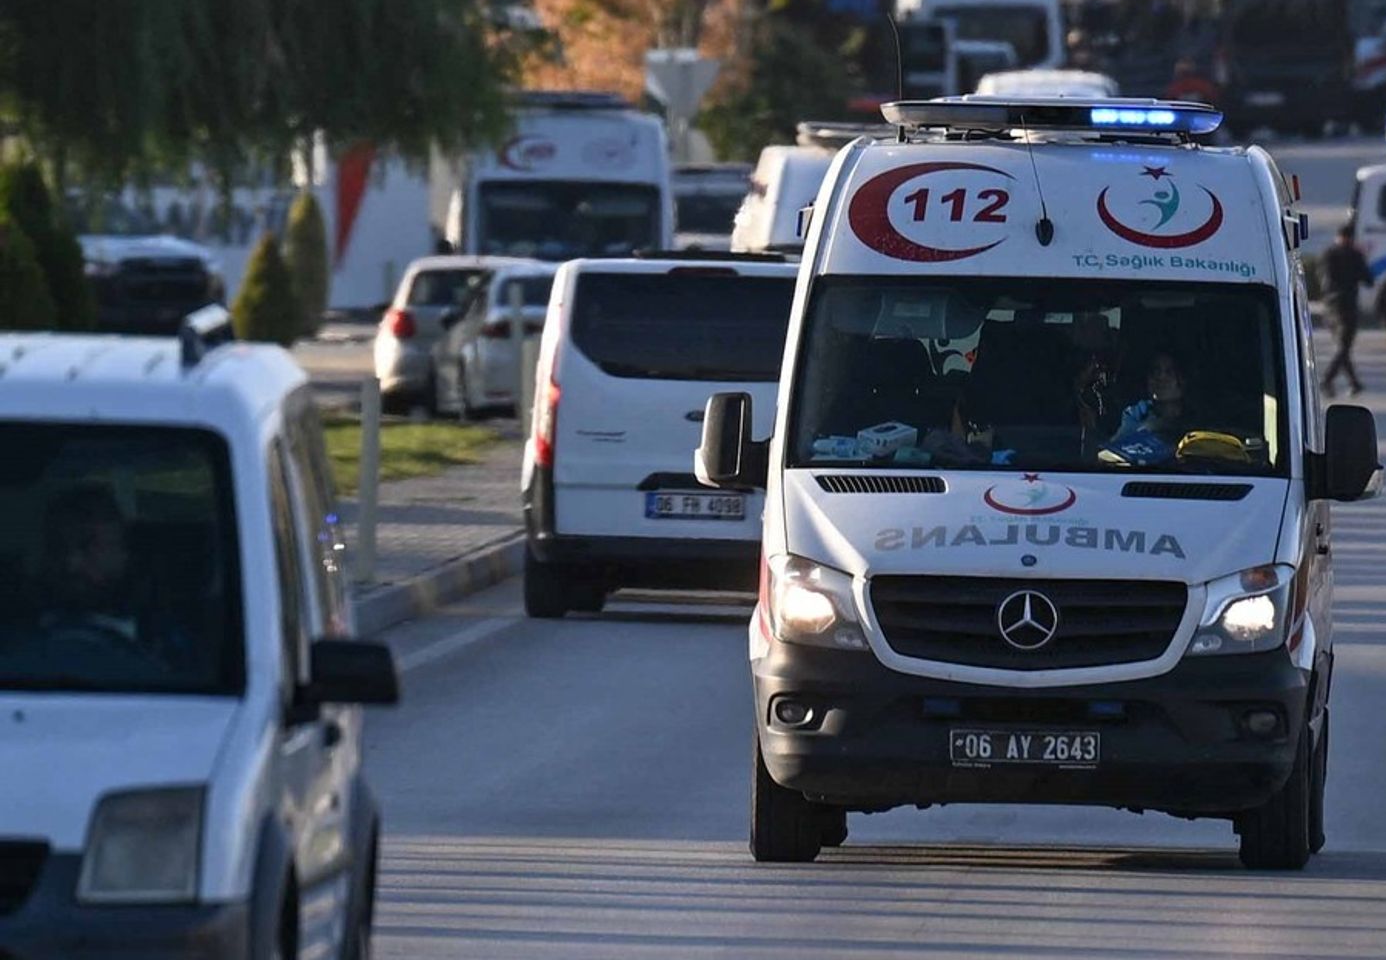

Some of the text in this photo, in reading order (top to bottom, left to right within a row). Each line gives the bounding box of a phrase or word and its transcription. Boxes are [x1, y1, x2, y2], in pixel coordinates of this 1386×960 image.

[904, 188, 1009, 223] 112
[1106, 254, 1165, 270] Sağlık
[1170, 256, 1257, 277] Bakanlığı
[965, 734, 1096, 760] 06 AY 2643
